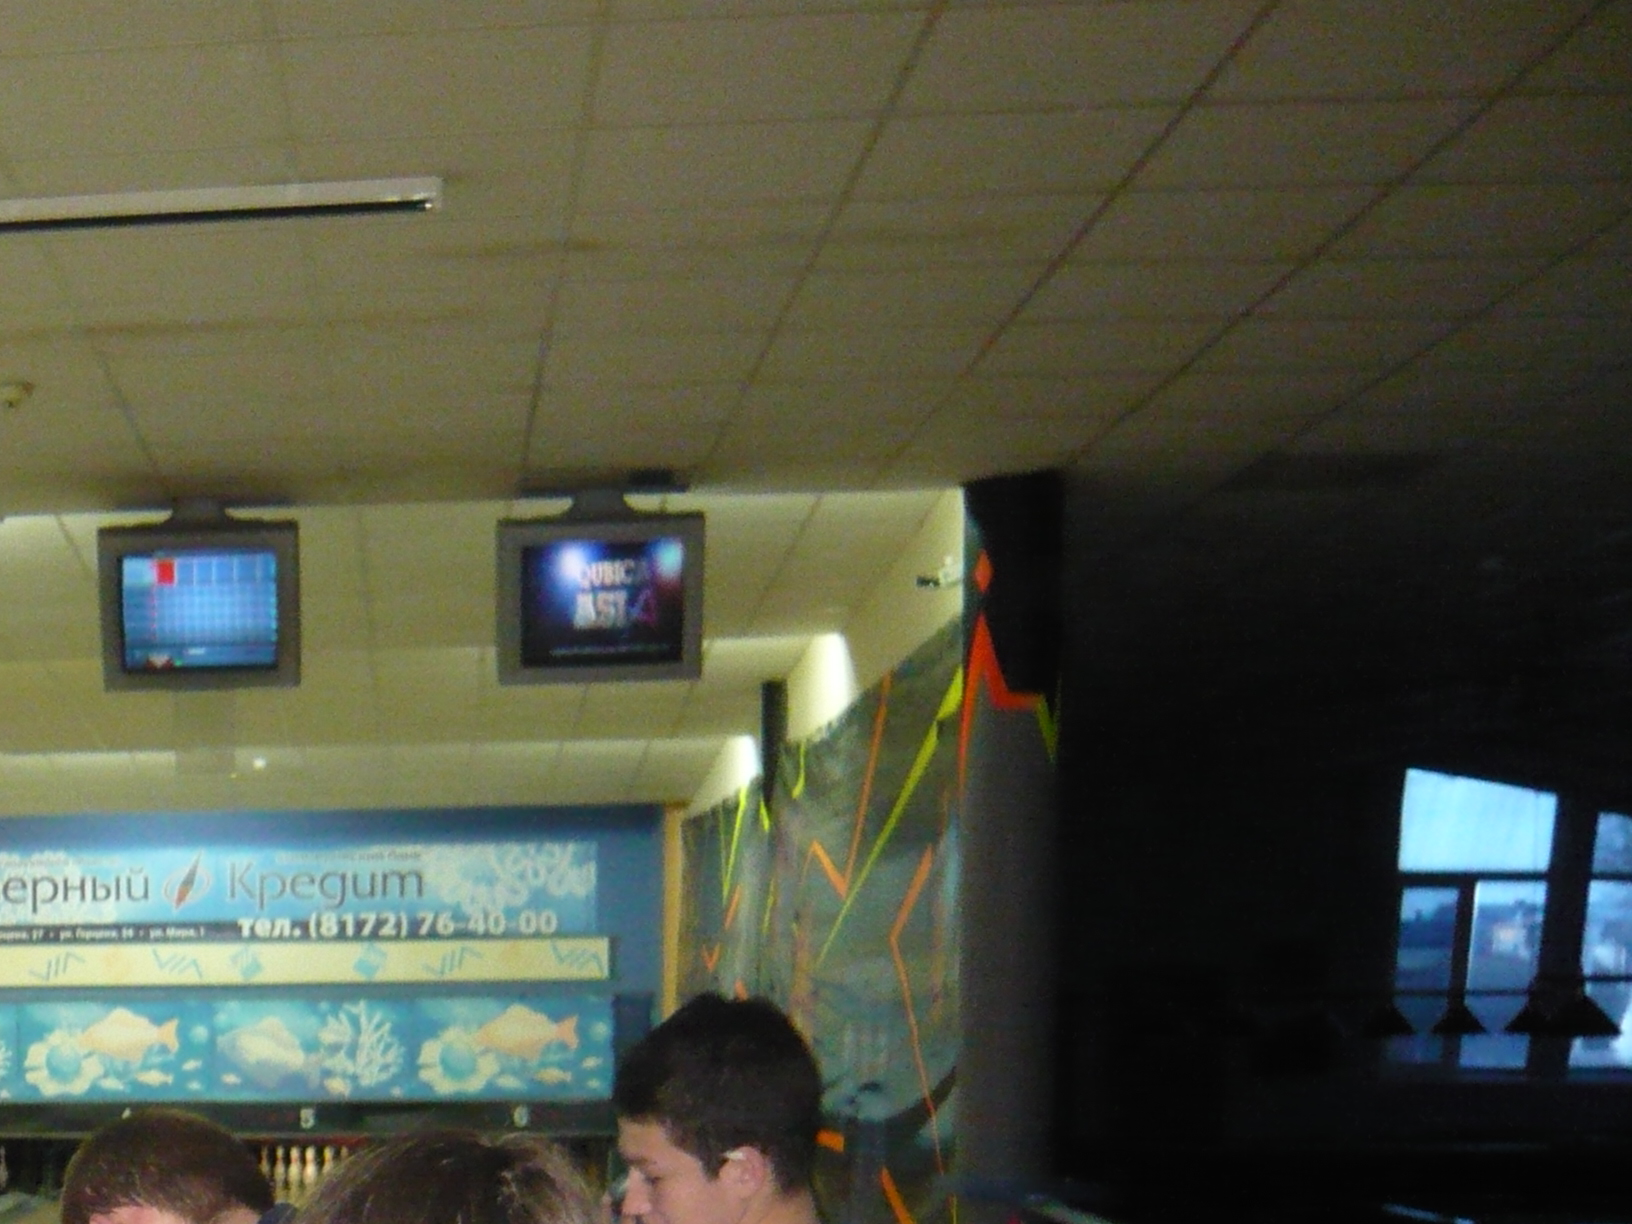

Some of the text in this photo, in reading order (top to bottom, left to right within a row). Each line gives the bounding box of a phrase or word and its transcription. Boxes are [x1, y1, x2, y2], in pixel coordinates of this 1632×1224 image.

[229, 861, 424, 911] Кредит
[238, 908, 558, 938] тел. (8172) 76-40-00
[299, 1107, 316, 1129] 5
